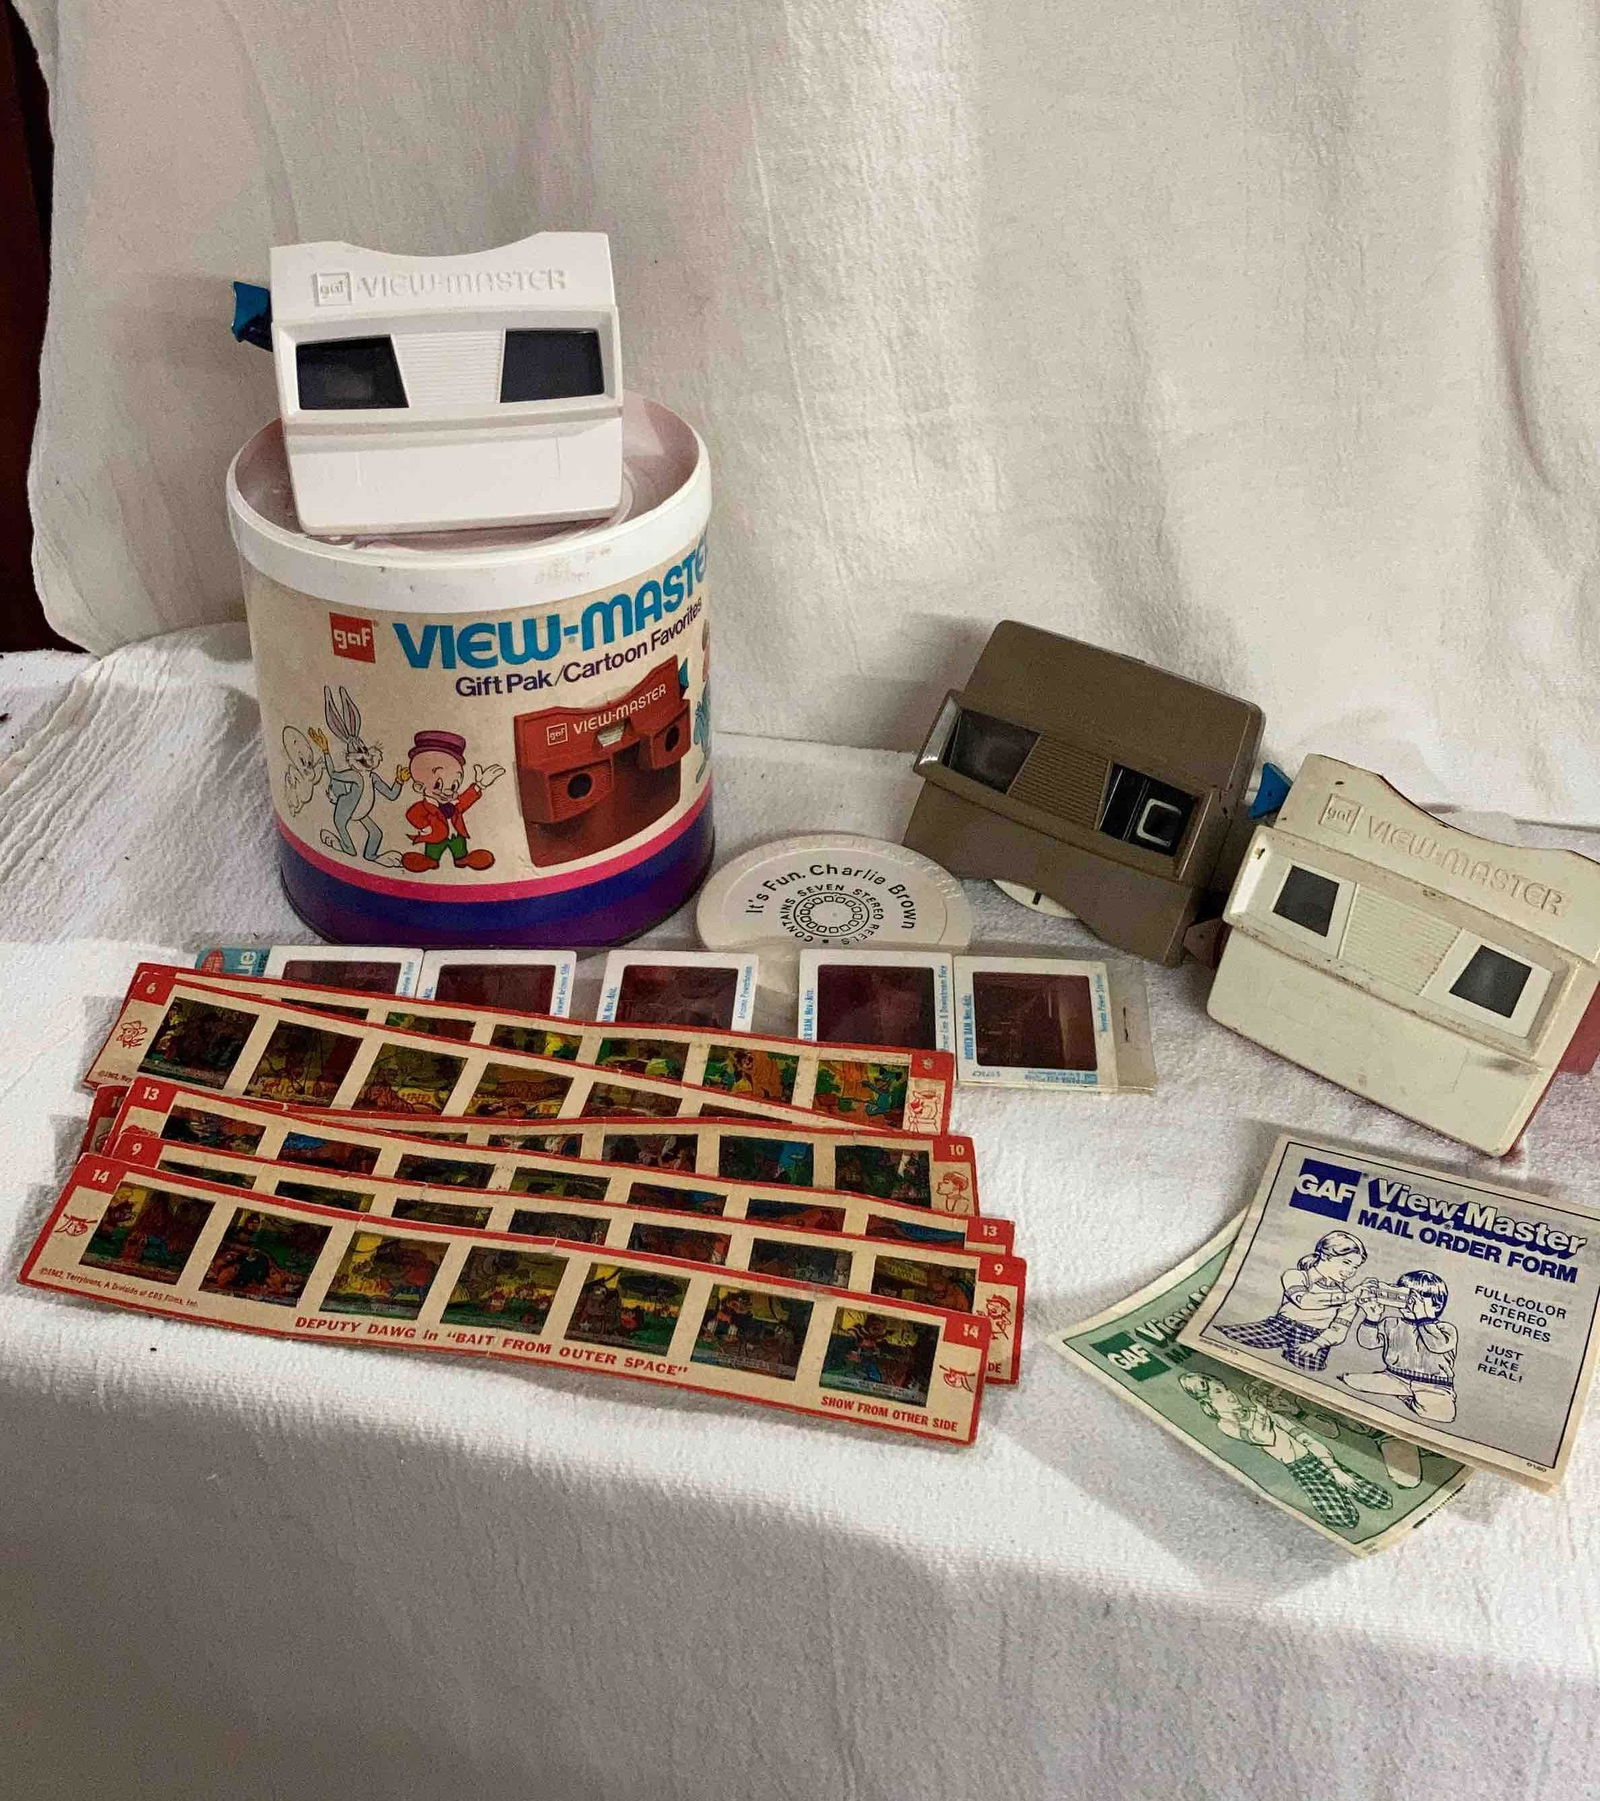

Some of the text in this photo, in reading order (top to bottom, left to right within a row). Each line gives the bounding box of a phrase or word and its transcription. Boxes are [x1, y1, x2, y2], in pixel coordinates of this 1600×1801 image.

[361, 268, 567, 298] VIEW-MASTER
[335, 632, 372, 651] gaf
[455, 674, 503, 697] Gift
[507, 642, 648, 694] Pak/Cartoon
[549, 683, 667, 741] gaf VIEW-MASTER
[1368, 814, 1563, 916] VIEW-MASTER
[745, 893, 770, 914] It's
[809, 864, 886, 885] Charlie
[888, 884, 917, 930] Brown
[779, 883, 884, 945] CONTAINS SEVEN STEREO REELS
[146, 982, 156, 994] 6
[143, 1086, 159, 1100] 13
[132, 1143, 142, 1156] 9
[949, 1144, 965, 1157] 10
[91, 1169, 110, 1184] 14
[982, 1225, 998, 1237] 13
[1295, 1173, 1588, 1260] GAF View-Master
[1357, 1209, 1579, 1284] MAIL ORDER FORM
[994, 1263, 1003, 1276] 9
[1474, 1285, 1567, 1320] FULL-COLOR
[1489, 1303, 1547, 1328] STEREO
[295, 1316, 362, 1334] DEPUTY
[367, 1324, 416, 1339] DAWG
[423, 1330, 439, 1341] in
[502, 1338, 552, 1355] FROM
[559, 1346, 618, 1363] OUTER
[962, 1324, 978, 1338] 14
[1479, 1314, 1551, 1343] PICTURES
[1107, 1342, 1151, 1371] GAF
[1484, 1355, 1520, 1372] LIKE
[1486, 1344, 1524, 1361] JUST
[821, 1395, 958, 1432] SHOW FROM OTHER SIDE
